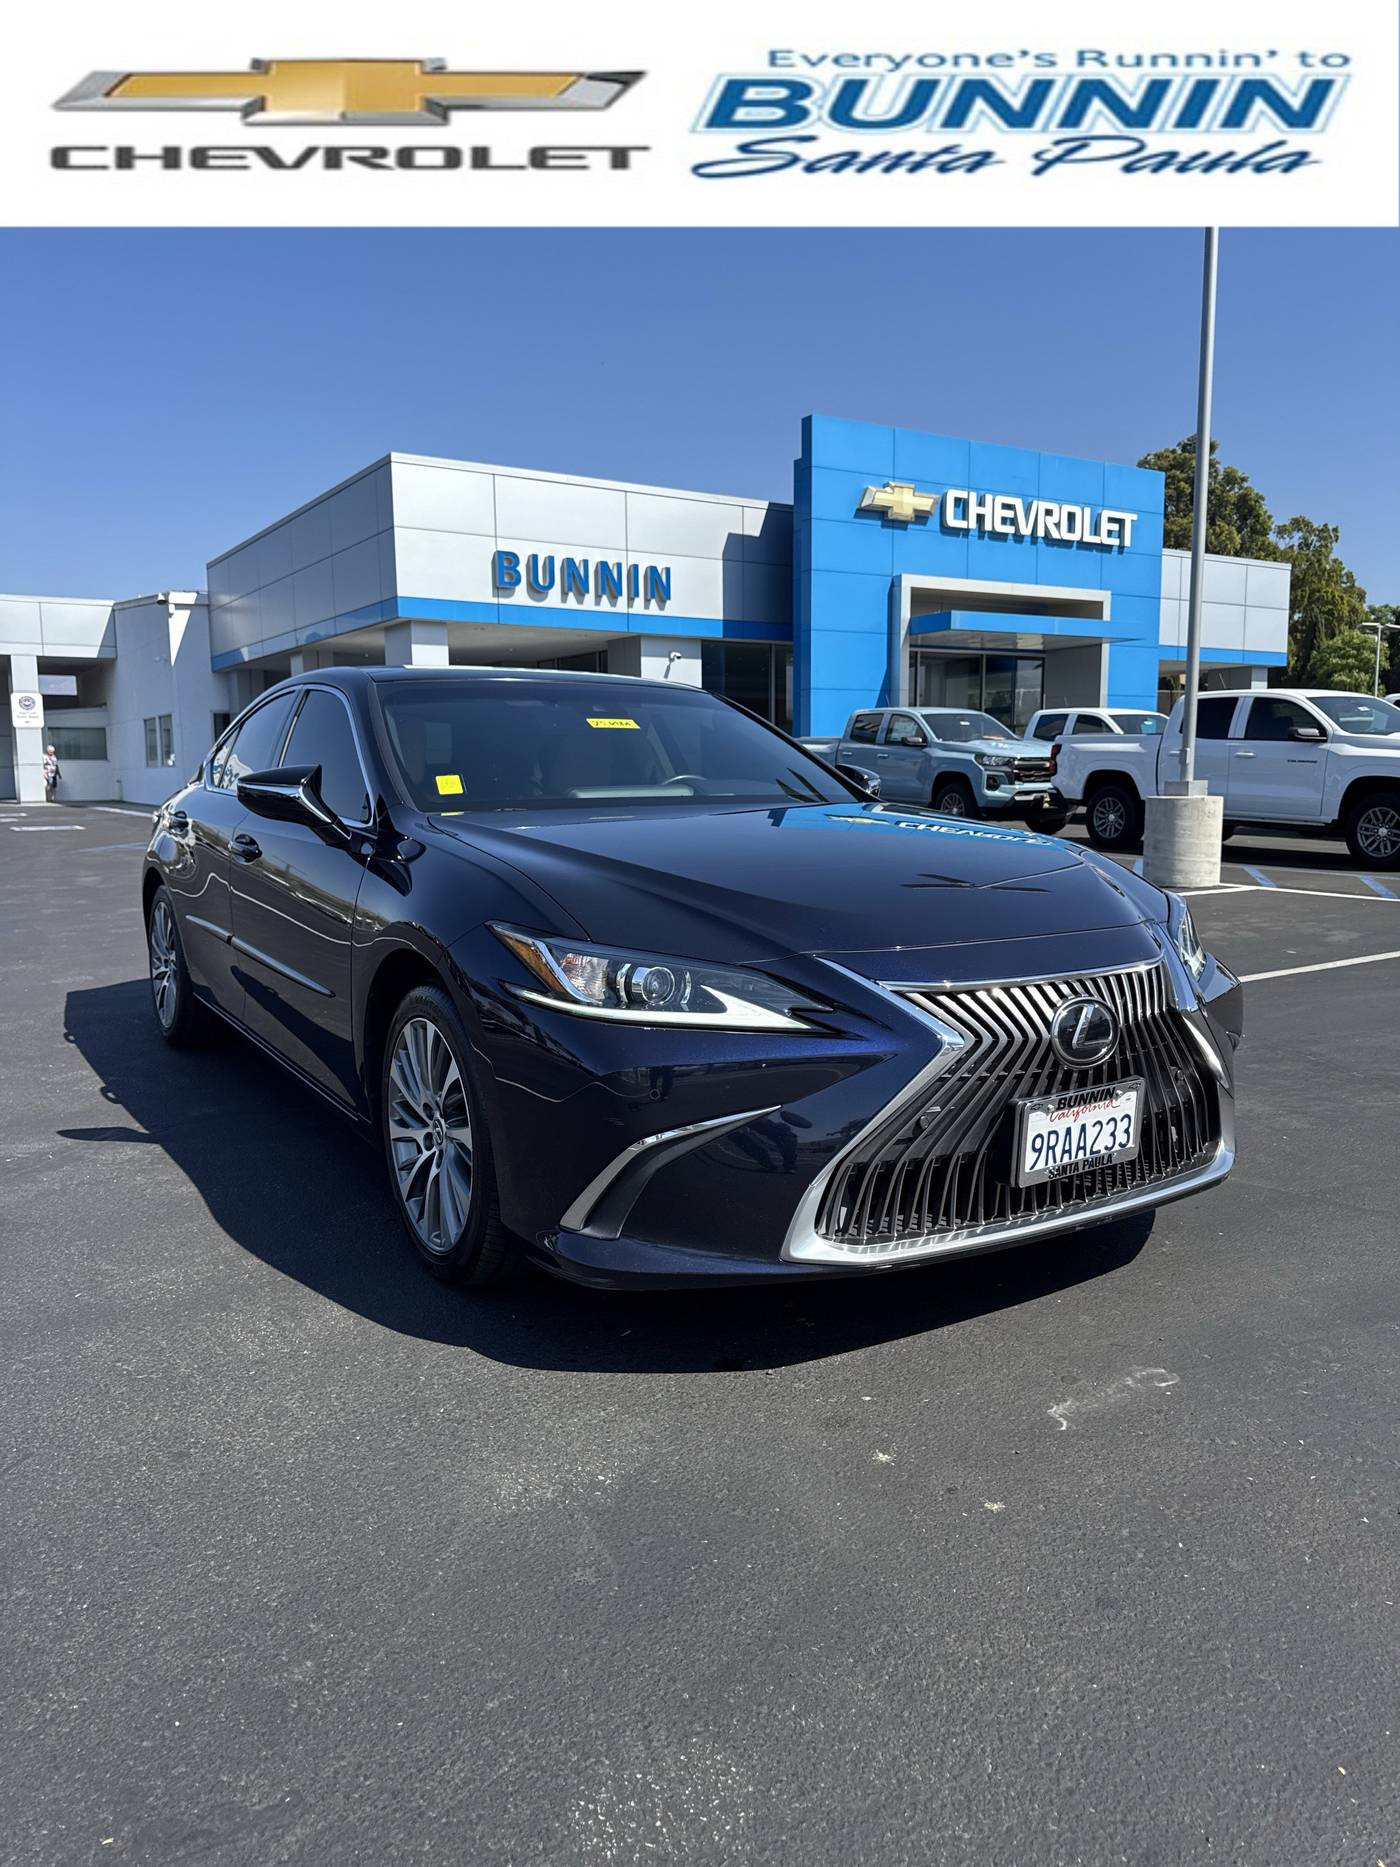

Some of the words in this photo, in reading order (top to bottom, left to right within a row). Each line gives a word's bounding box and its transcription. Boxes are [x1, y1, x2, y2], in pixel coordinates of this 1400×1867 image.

[943, 488, 1139, 548] CHEVROLET
[493, 550, 672, 602] BUNNIN
[1057, 1087, 1116, 1111] BUNNIN
[1029, 1113, 1132, 1171] 9RAA233
[1048, 1160, 1080, 1179] SANTA
[1082, 1153, 1113, 1171] PAULA
